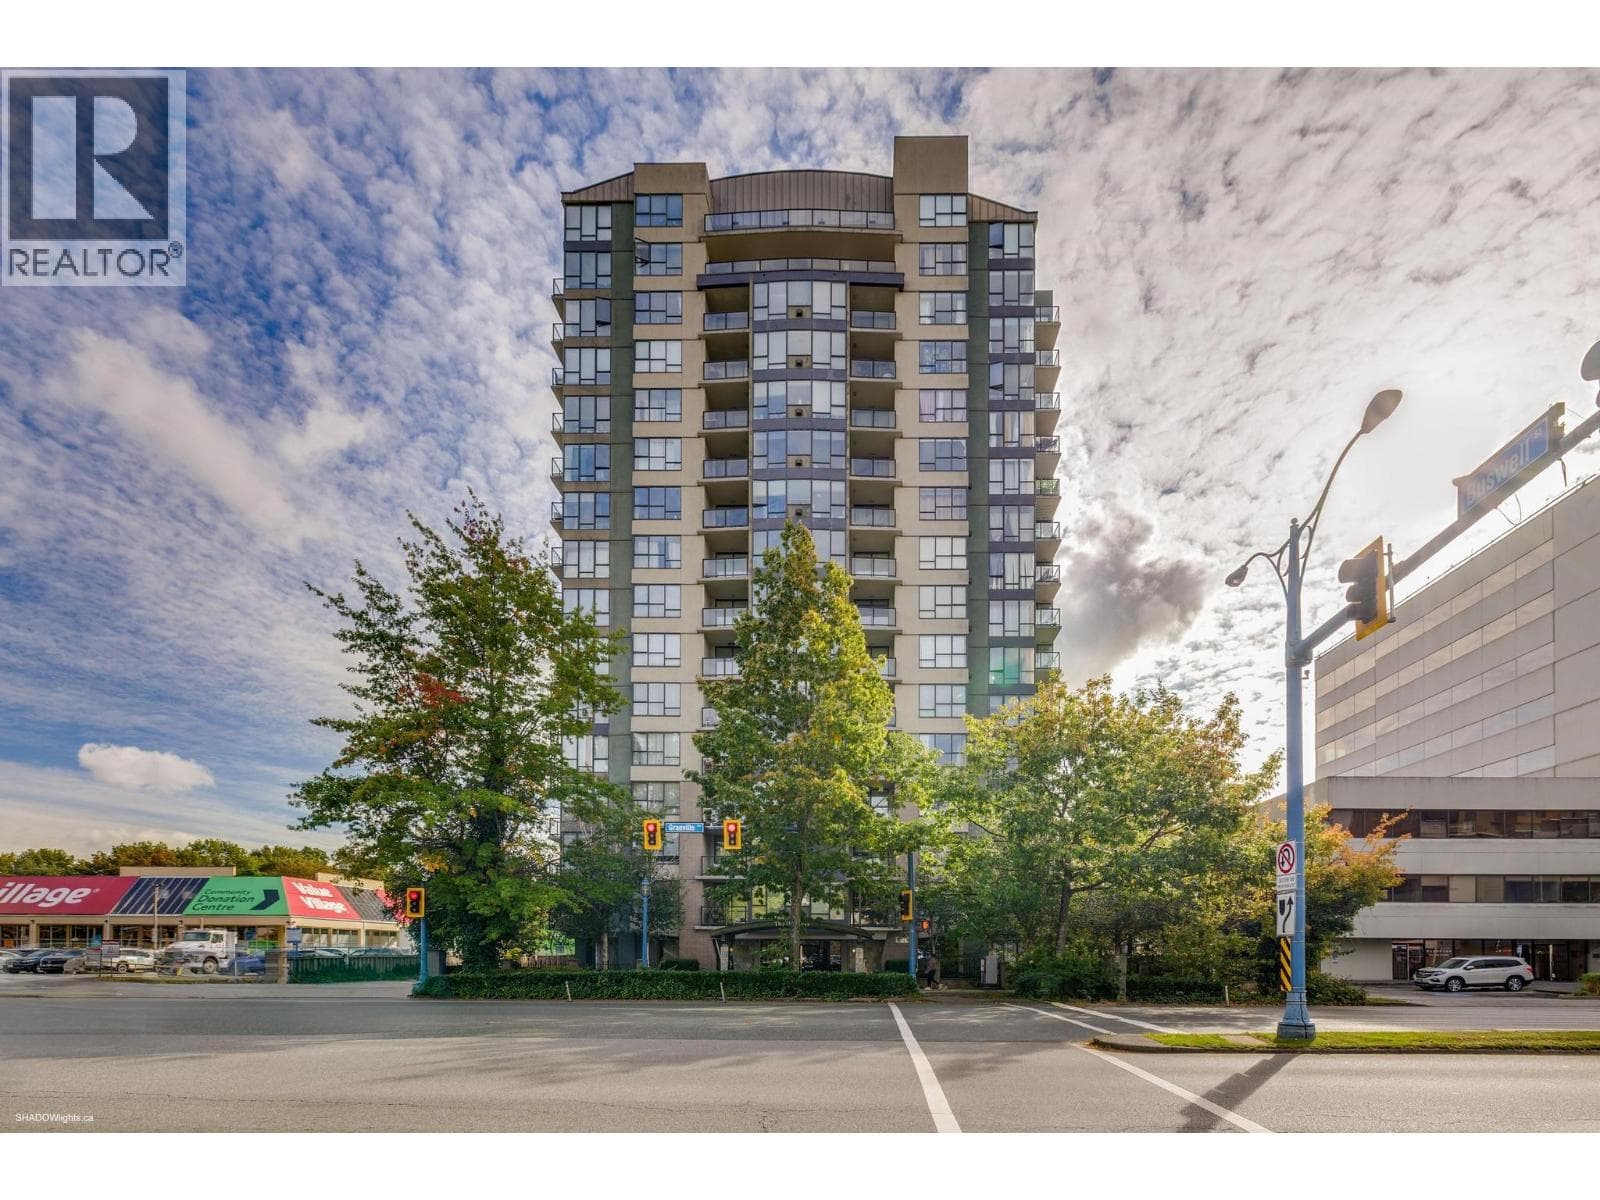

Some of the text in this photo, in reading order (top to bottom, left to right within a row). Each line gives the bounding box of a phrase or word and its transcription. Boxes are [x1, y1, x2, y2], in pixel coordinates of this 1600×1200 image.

[292, 881, 334, 898] Value
[198, 894, 255, 902] Donation
[300, 896, 348, 913] Village
[192, 902, 235, 911] Centre
